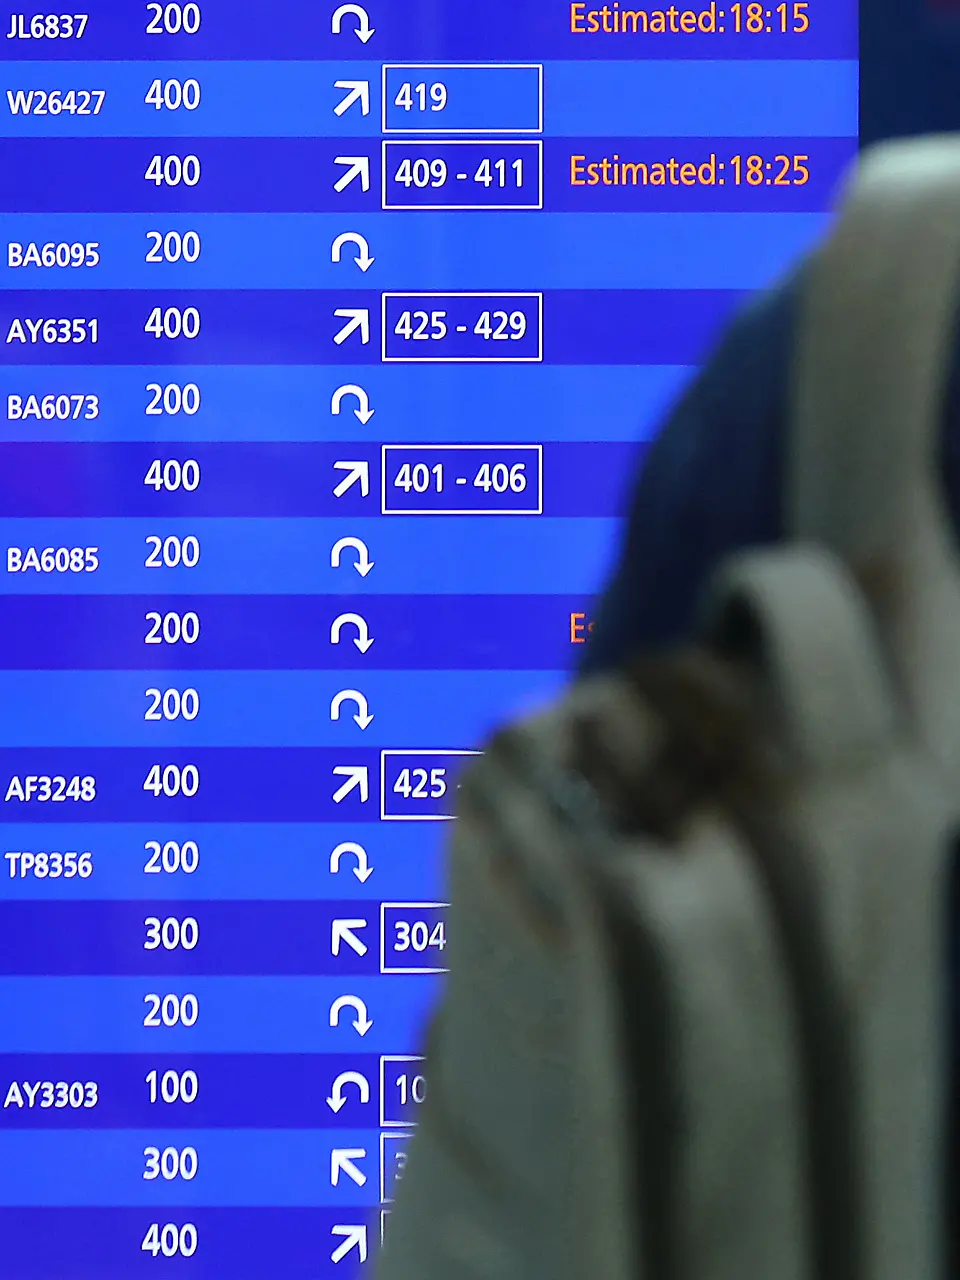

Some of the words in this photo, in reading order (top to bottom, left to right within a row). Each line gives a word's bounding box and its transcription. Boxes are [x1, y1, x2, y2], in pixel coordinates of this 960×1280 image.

[6, 14, 88, 39] JL6837
[146, 2, 201, 34] 200
[570, 1, 809, 34] Estimated:18:15
[6, 90, 106, 115] W26427
[144, 78, 201, 110] 400
[394, 82, 447, 112] 419
[144, 155, 201, 186] 400
[394, 158, 447, 188] 409
[474, 158, 523, 188] 411
[570, 153, 809, 186] Estimated:18:25
[8, 242, 100, 268] BA6095
[145, 231, 201, 263] 200
[6, 318, 98, 344] AY6351
[144, 307, 200, 339] 400
[394, 311, 447, 340] 425
[473, 310, 526, 340] 429
[7, 394, 99, 420] BA6073
[145, 383, 200, 415] 200
[144, 459, 200, 491] 400
[394, 463, 443, 493] 401
[473, 463, 527, 493] 406
[7, 547, 99, 573] BA6085
[145, 535, 200, 568] 200
[144, 612, 200, 644] 200
[144, 688, 199, 721] 200
[4, 775, 96, 802] AF3248
[143, 764, 199, 797] 400
[393, 768, 446, 798] 425
[4, 852, 93, 878] TP8356
[144, 840, 199, 874] 200
[143, 917, 199, 950] 300
[394, 921, 447, 952] 304
[143, 993, 199, 1027] 200
[3, 1081, 98, 1108] AY3303
[145, 1070, 198, 1104] 100
[143, 1146, 198, 1180] 300
[141, 1223, 198, 1257] 400
